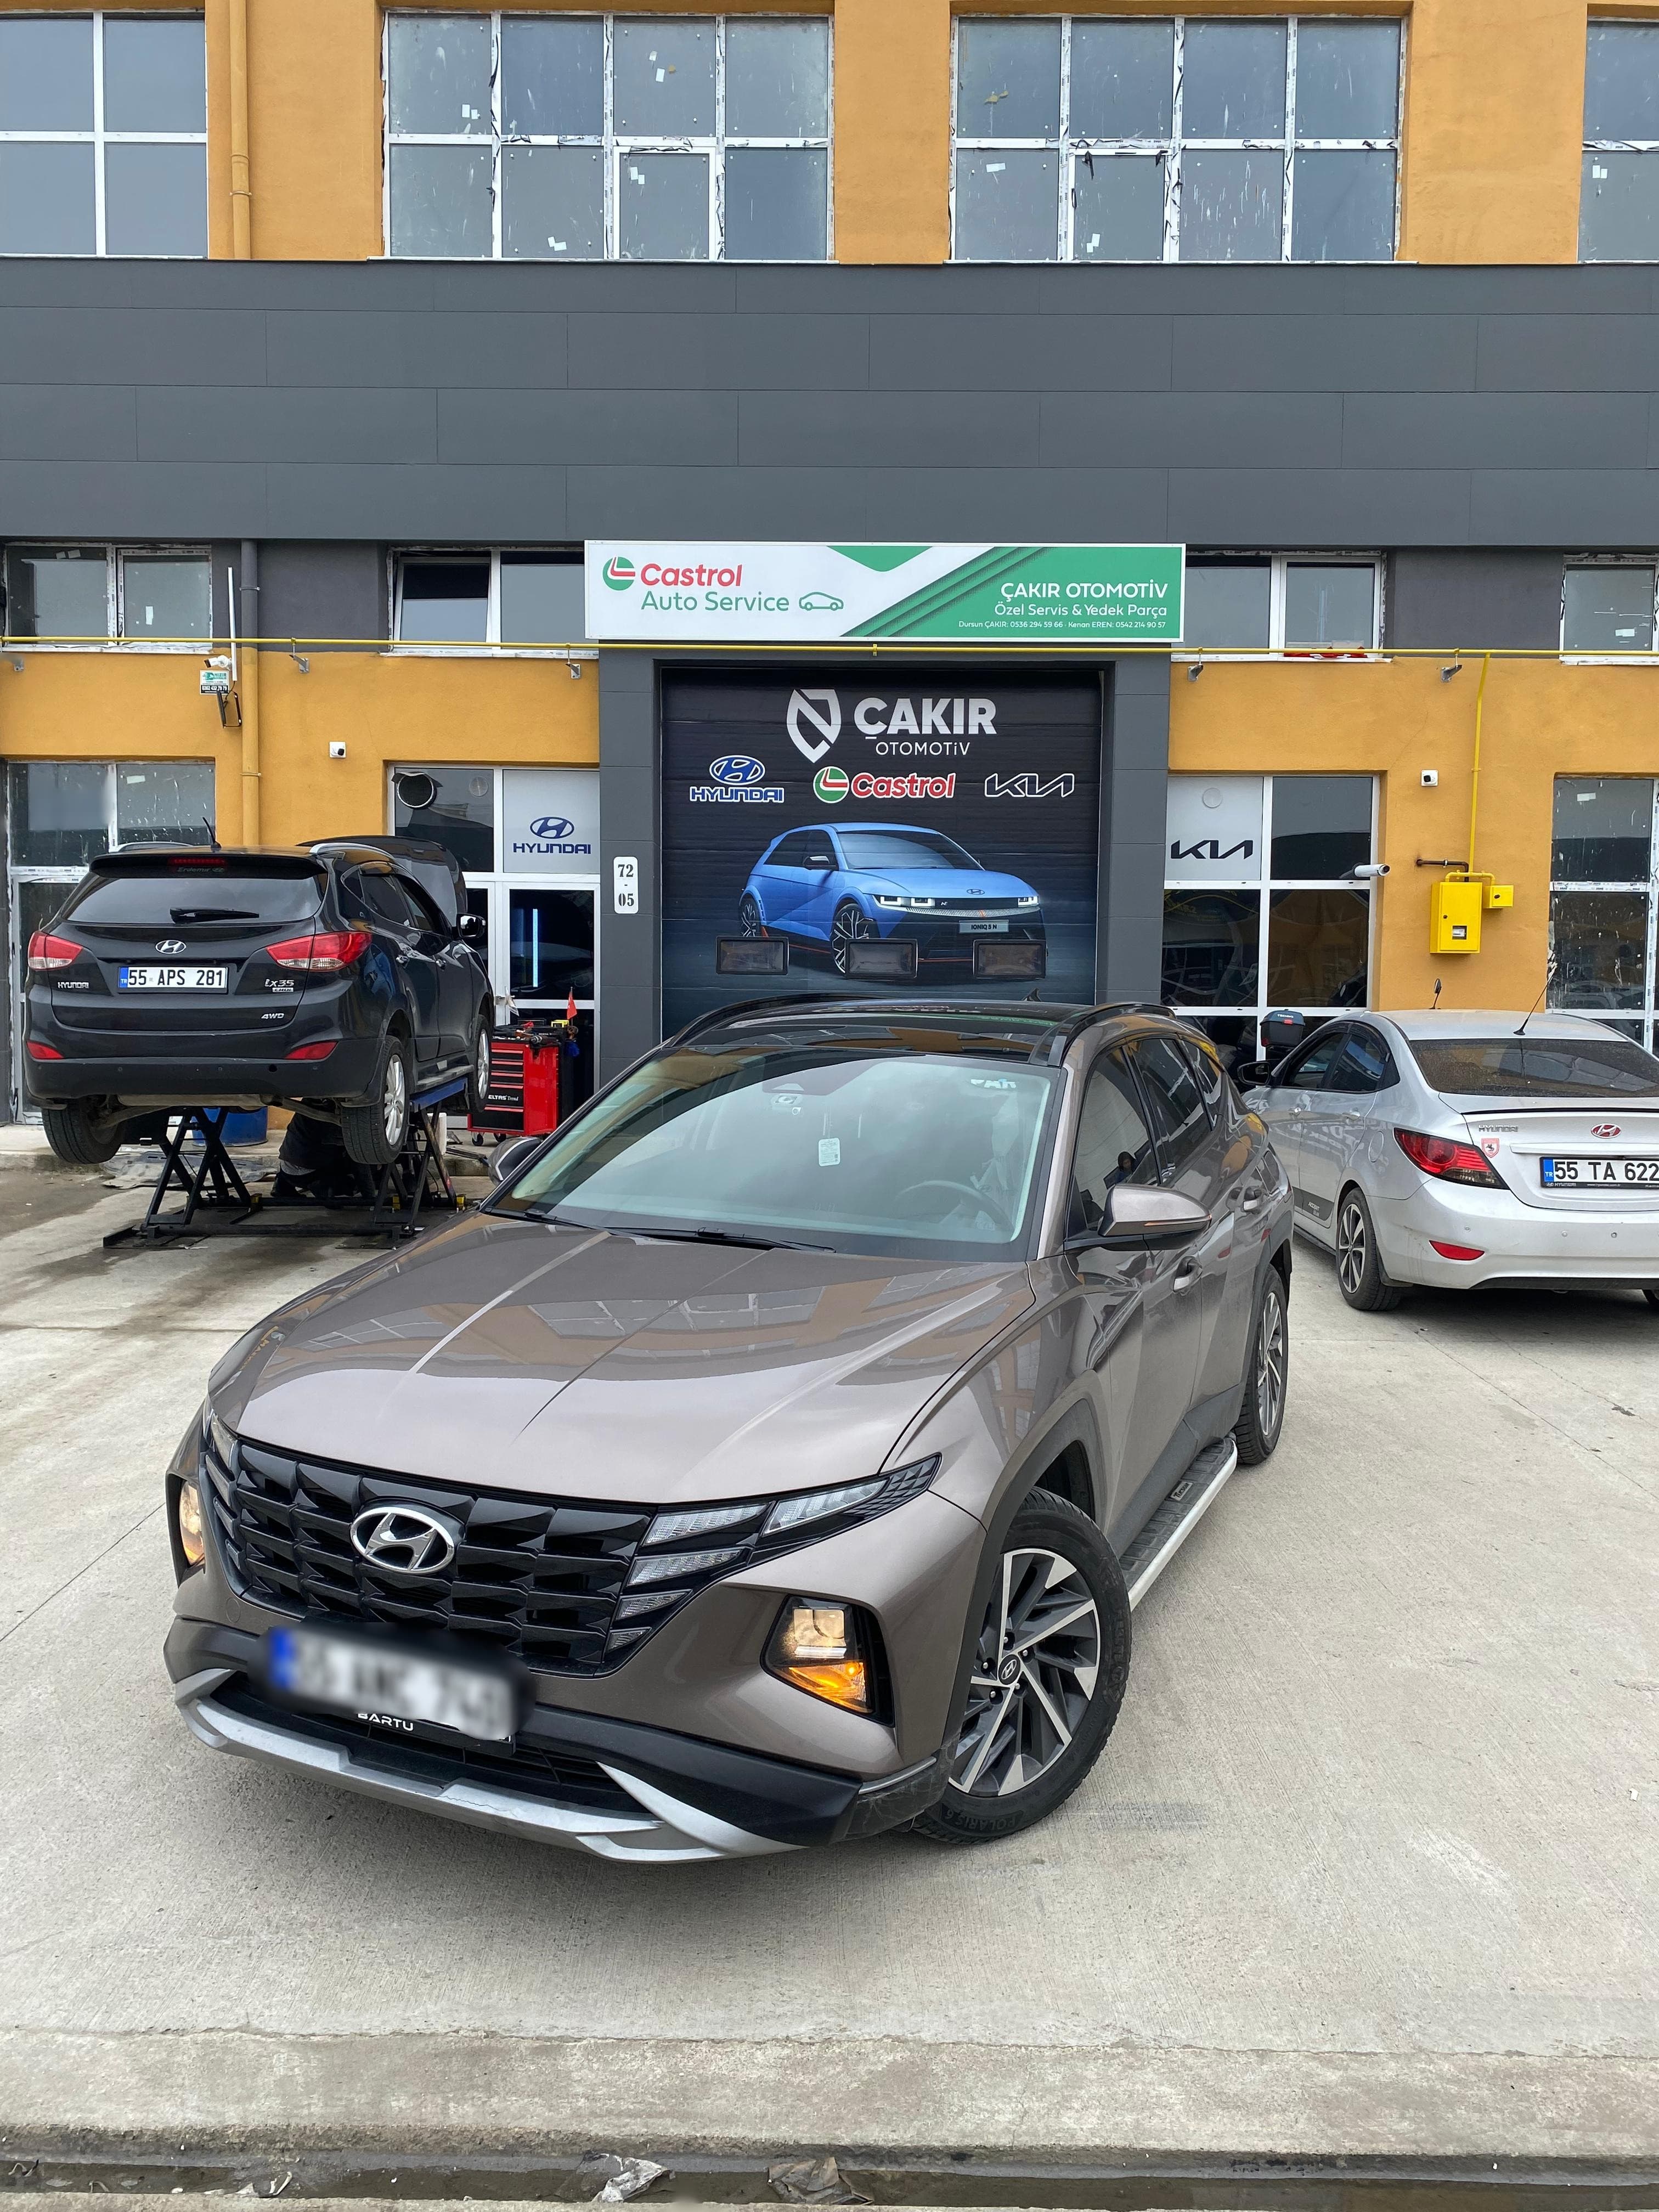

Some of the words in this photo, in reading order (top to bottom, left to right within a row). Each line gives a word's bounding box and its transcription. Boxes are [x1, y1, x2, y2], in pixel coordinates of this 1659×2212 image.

[640, 563, 743, 586] Castrol
[1001, 583, 1060, 602] ÇAKIR
[1065, 579, 1169, 599] OTOMOTİV
[641, 591, 697, 611] Auto
[705, 591, 789, 611] Service
[994, 601, 1024, 616] Özel
[1028, 604, 1068, 616] Servis
[1072, 604, 1082, 616] &
[1085, 604, 1124, 616] Yedek
[1127, 605, 1167, 619] Parça
[851, 772, 956, 799] Castrol
[984, 772, 1075, 798] KIA
[690, 786, 785, 803] HYUNDAI
[513, 843, 591, 855] HYUNDAI
[1171, 840, 1253, 859] KIA
[618, 864, 634, 878] 72
[618, 893, 635, 907] 05
[129, 969, 147, 985] 55
[157, 969, 185, 986] APS
[196, 969, 223, 986] 281
[1479, 1124, 1519, 1132] HYUNDAI
[1554, 1161, 1578, 1180] 55
[1588, 1161, 1616, 1181] TA
[1624, 1163, 1659, 1181] 622
[358, 1713, 414, 1731] BARTU
